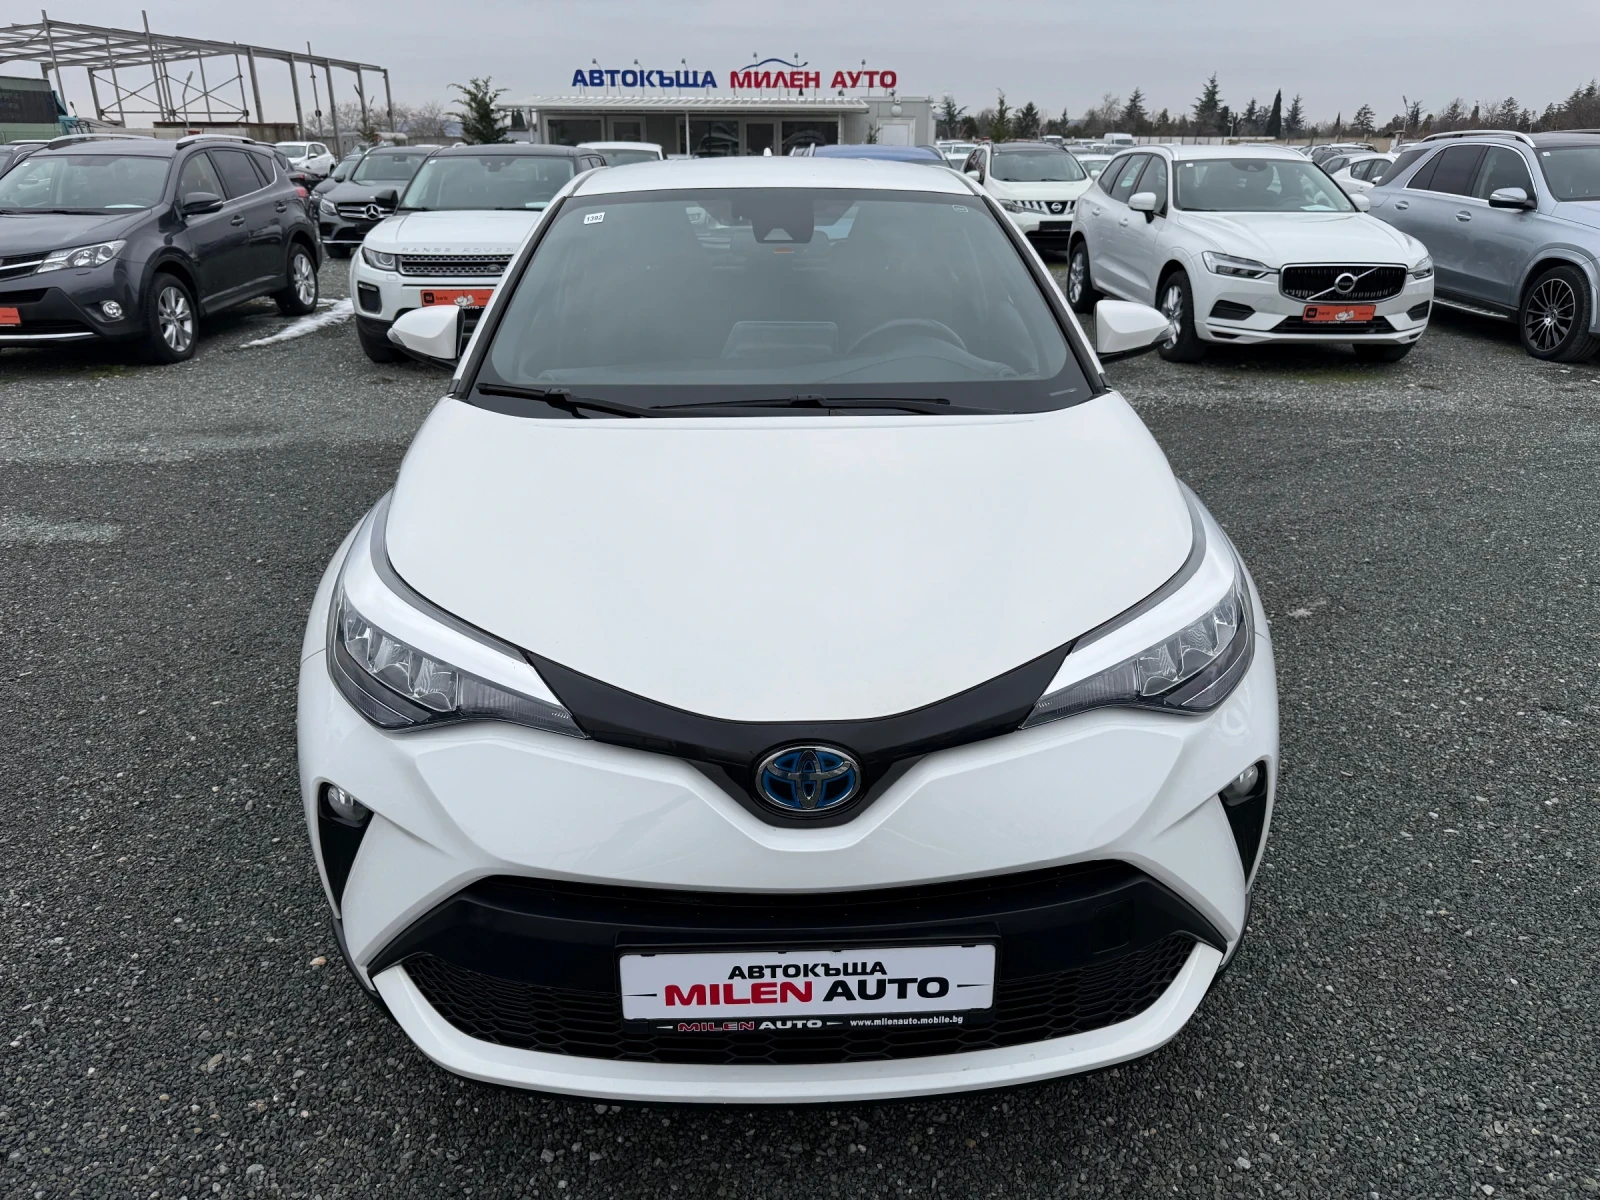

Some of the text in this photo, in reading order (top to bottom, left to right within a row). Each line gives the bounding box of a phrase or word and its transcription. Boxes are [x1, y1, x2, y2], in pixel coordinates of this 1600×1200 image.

[572, 69, 898, 89] АВТОКЪЩА МИЛЕН АУТО
[586, 214, 603, 222] 1392
[727, 961, 888, 980] АВТОКЪЩА
[664, 976, 950, 1007] MILEN AUTO
[676, 1015, 964, 1032] MILEN AUTO www.milenauto.mobile.bg
